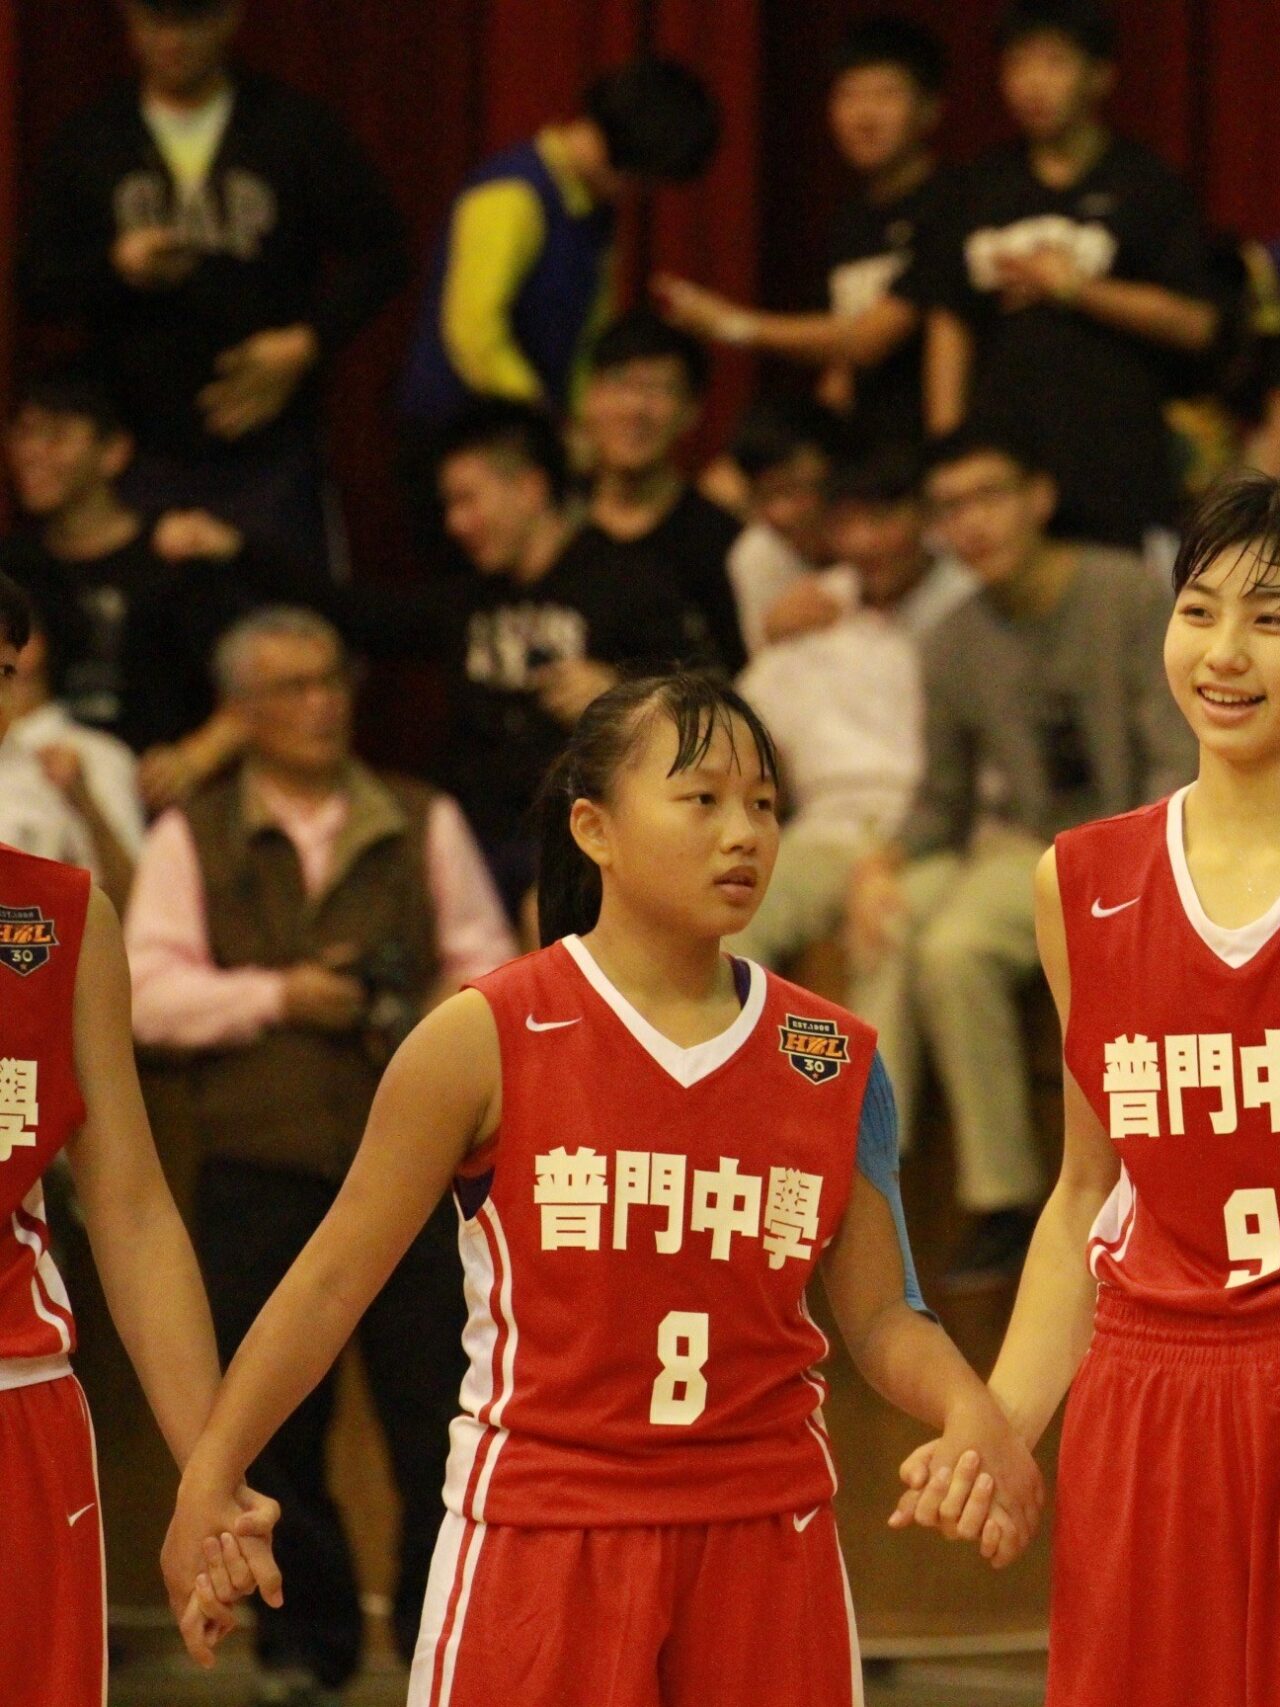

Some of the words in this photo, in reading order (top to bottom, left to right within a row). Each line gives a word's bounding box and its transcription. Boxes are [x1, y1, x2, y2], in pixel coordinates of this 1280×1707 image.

[11, 949, 33, 962] 30
[803, 1058, 825, 1073] 30
[533, 1145, 824, 1271] 普門中學
[649, 1310, 709, 1426] 8
